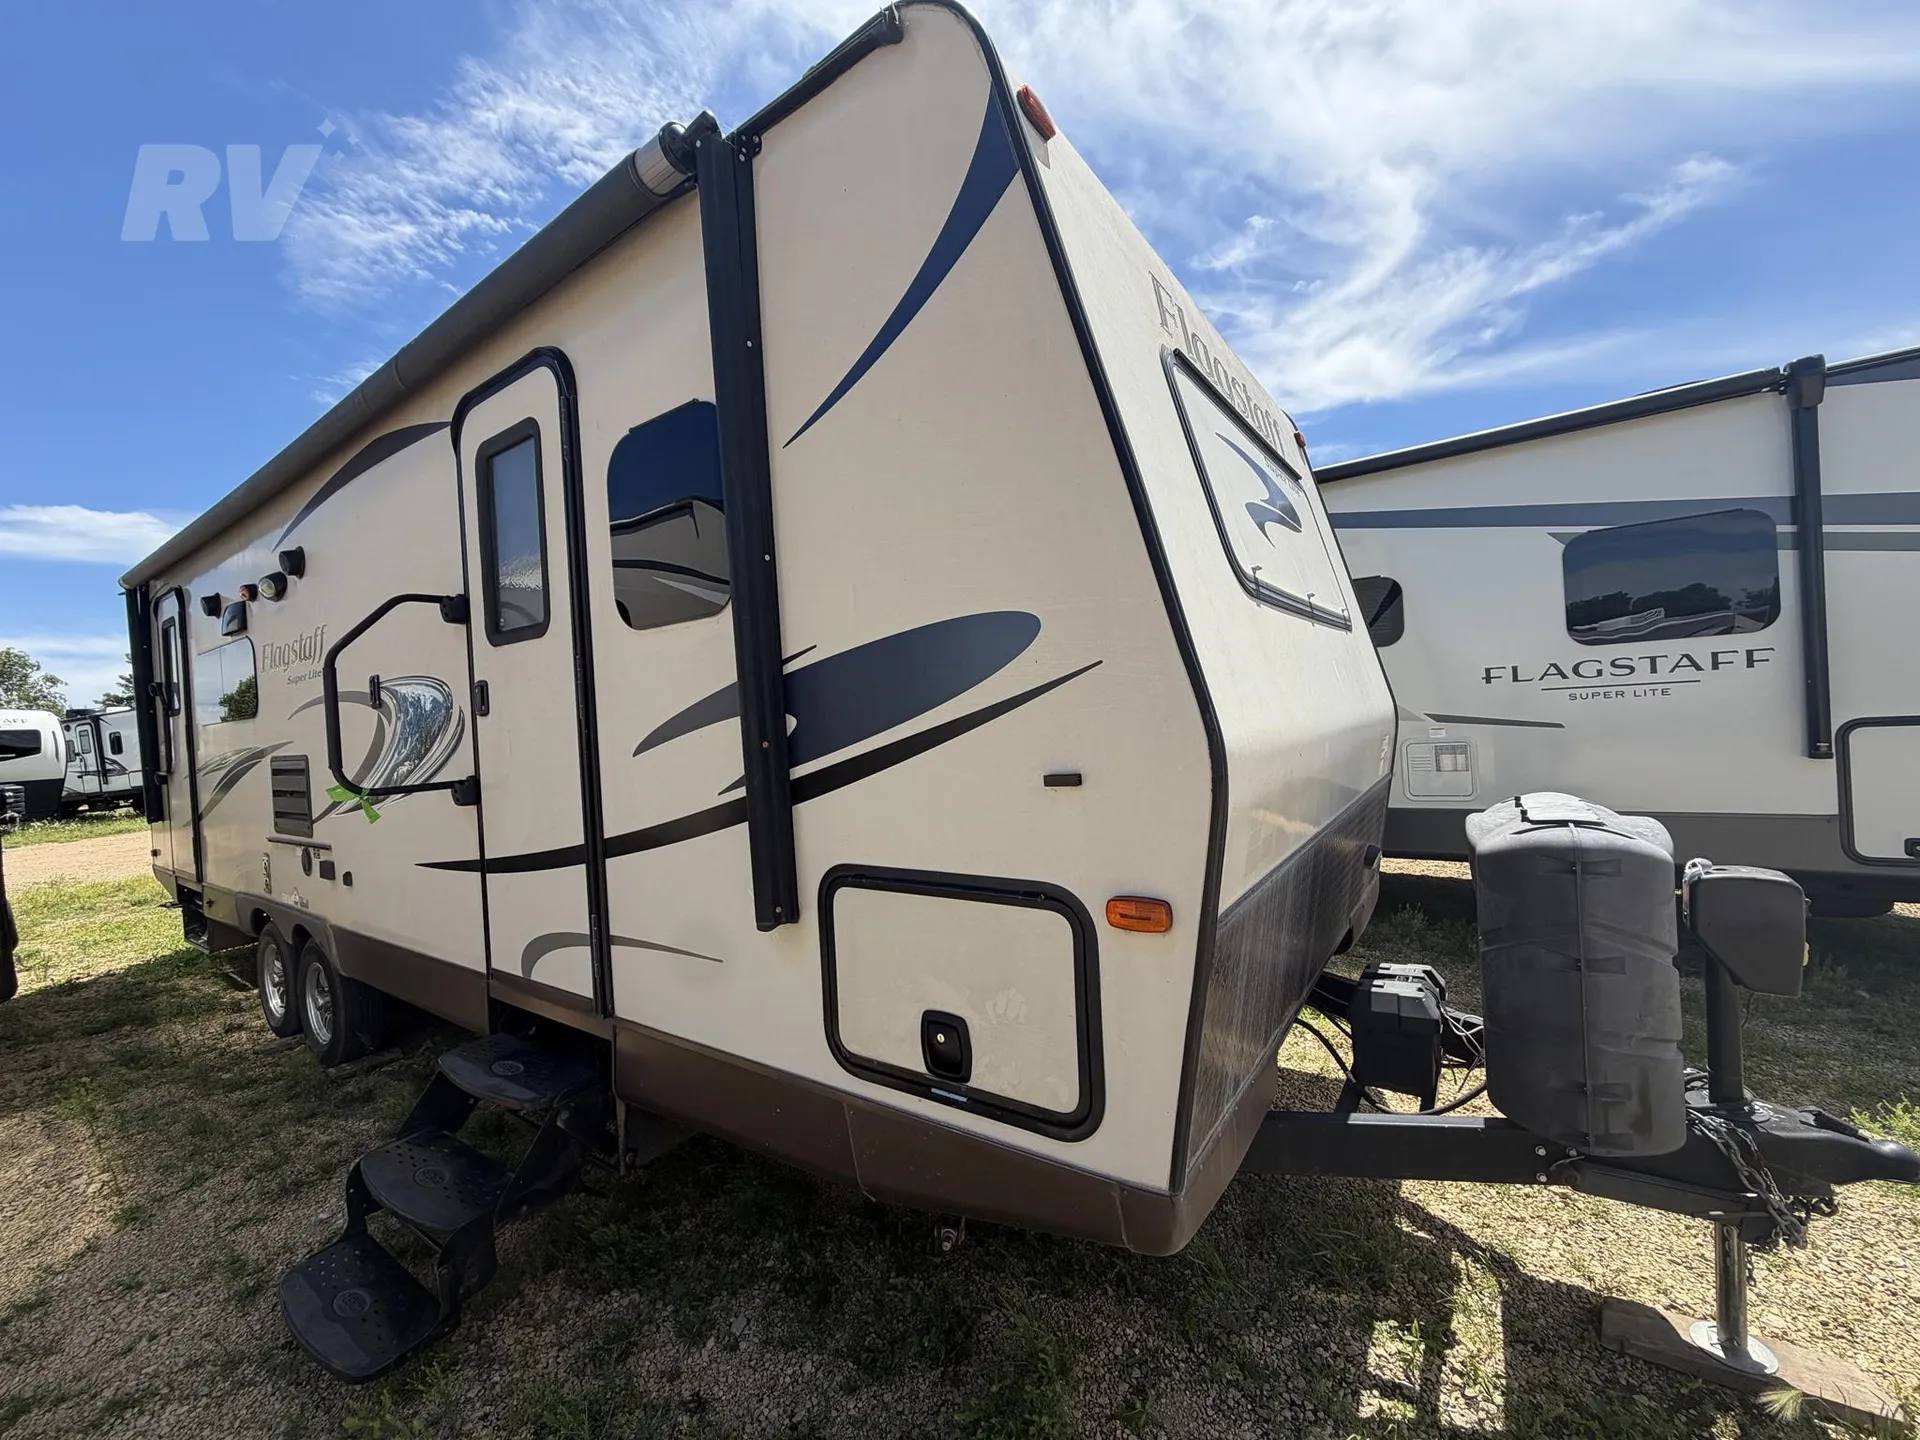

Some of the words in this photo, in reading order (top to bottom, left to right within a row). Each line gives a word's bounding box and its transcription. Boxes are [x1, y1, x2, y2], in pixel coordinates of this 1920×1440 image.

[261, 623, 327, 674] Flagstaff
[287, 674, 308, 686] Super
[308, 668, 323, 681] Lite
[1481, 647, 1776, 685] FLAGSTAFF
[1568, 690, 1626, 701] SUPER
[1633, 687, 1672, 698] LITE
